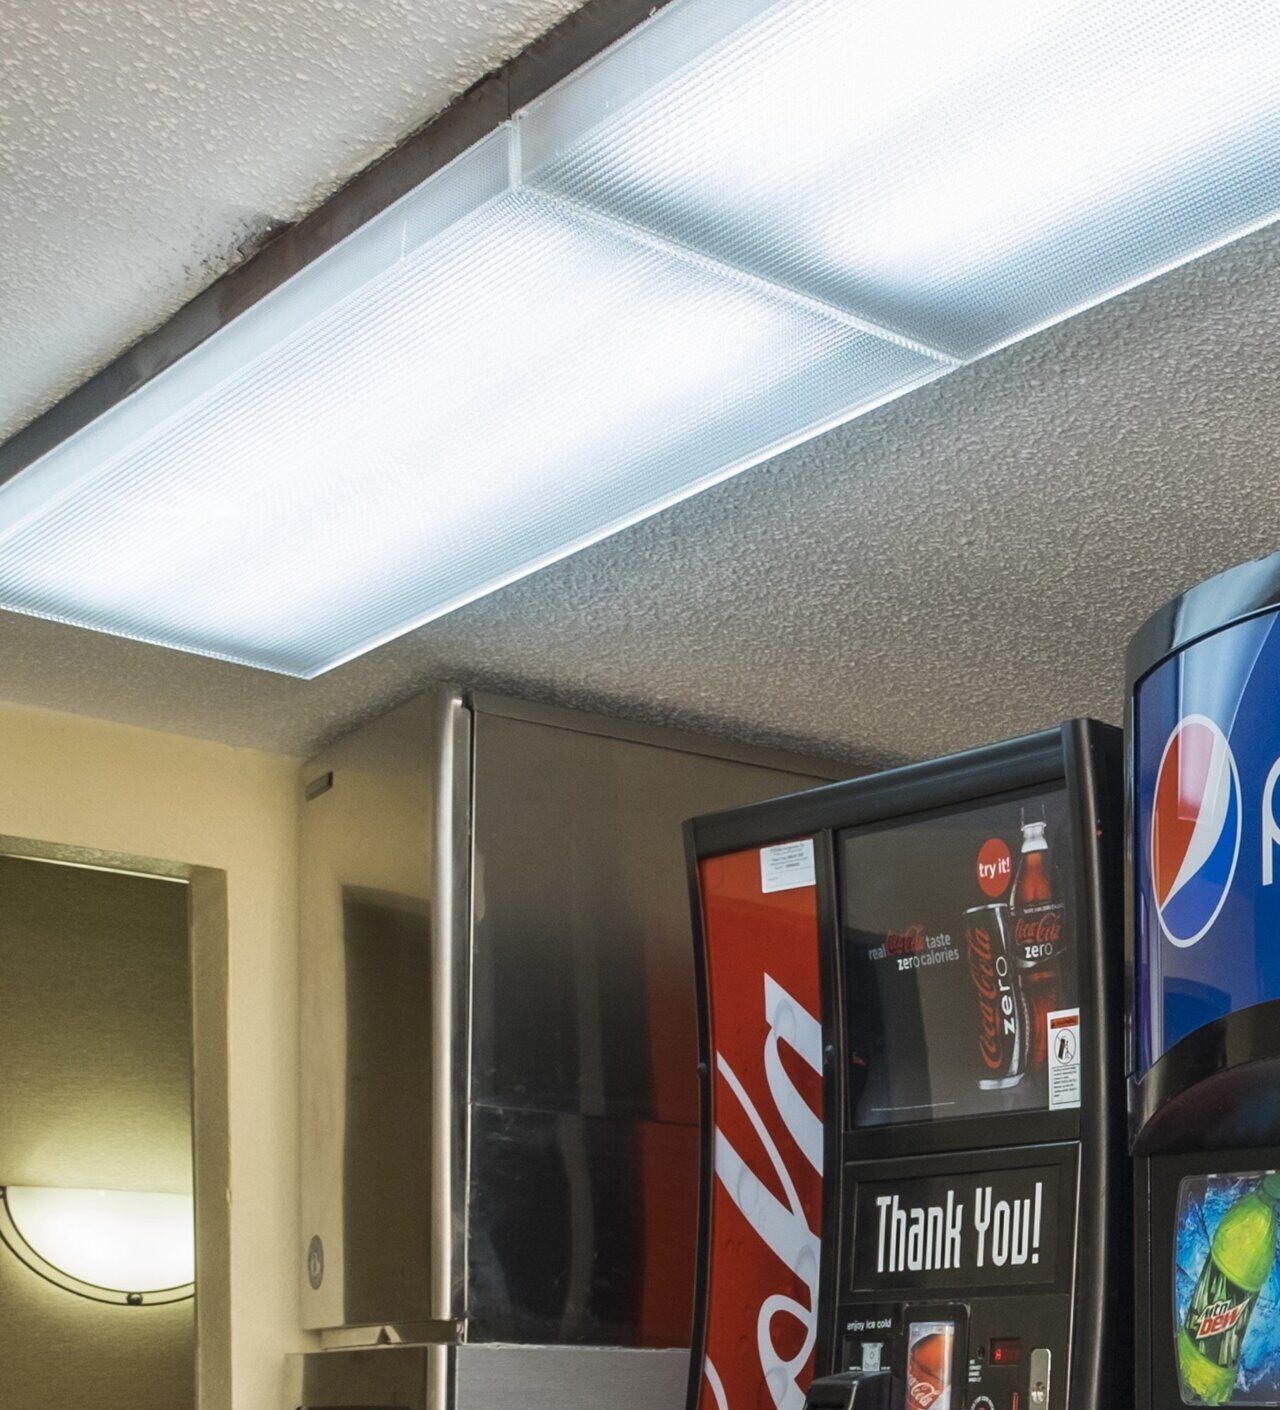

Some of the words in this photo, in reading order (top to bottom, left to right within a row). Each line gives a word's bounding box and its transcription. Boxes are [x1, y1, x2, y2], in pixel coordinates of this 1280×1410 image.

[978, 863, 996, 879] try
[997, 856, 1010, 875] it!
[925, 933, 951, 951] taste
[1024, 942, 1053, 959] zero
[897, 953, 920, 971] zero
[921, 947, 960, 967] calories
[995, 955, 1016, 1036] zero
[875, 1189, 964, 1274] Thank
